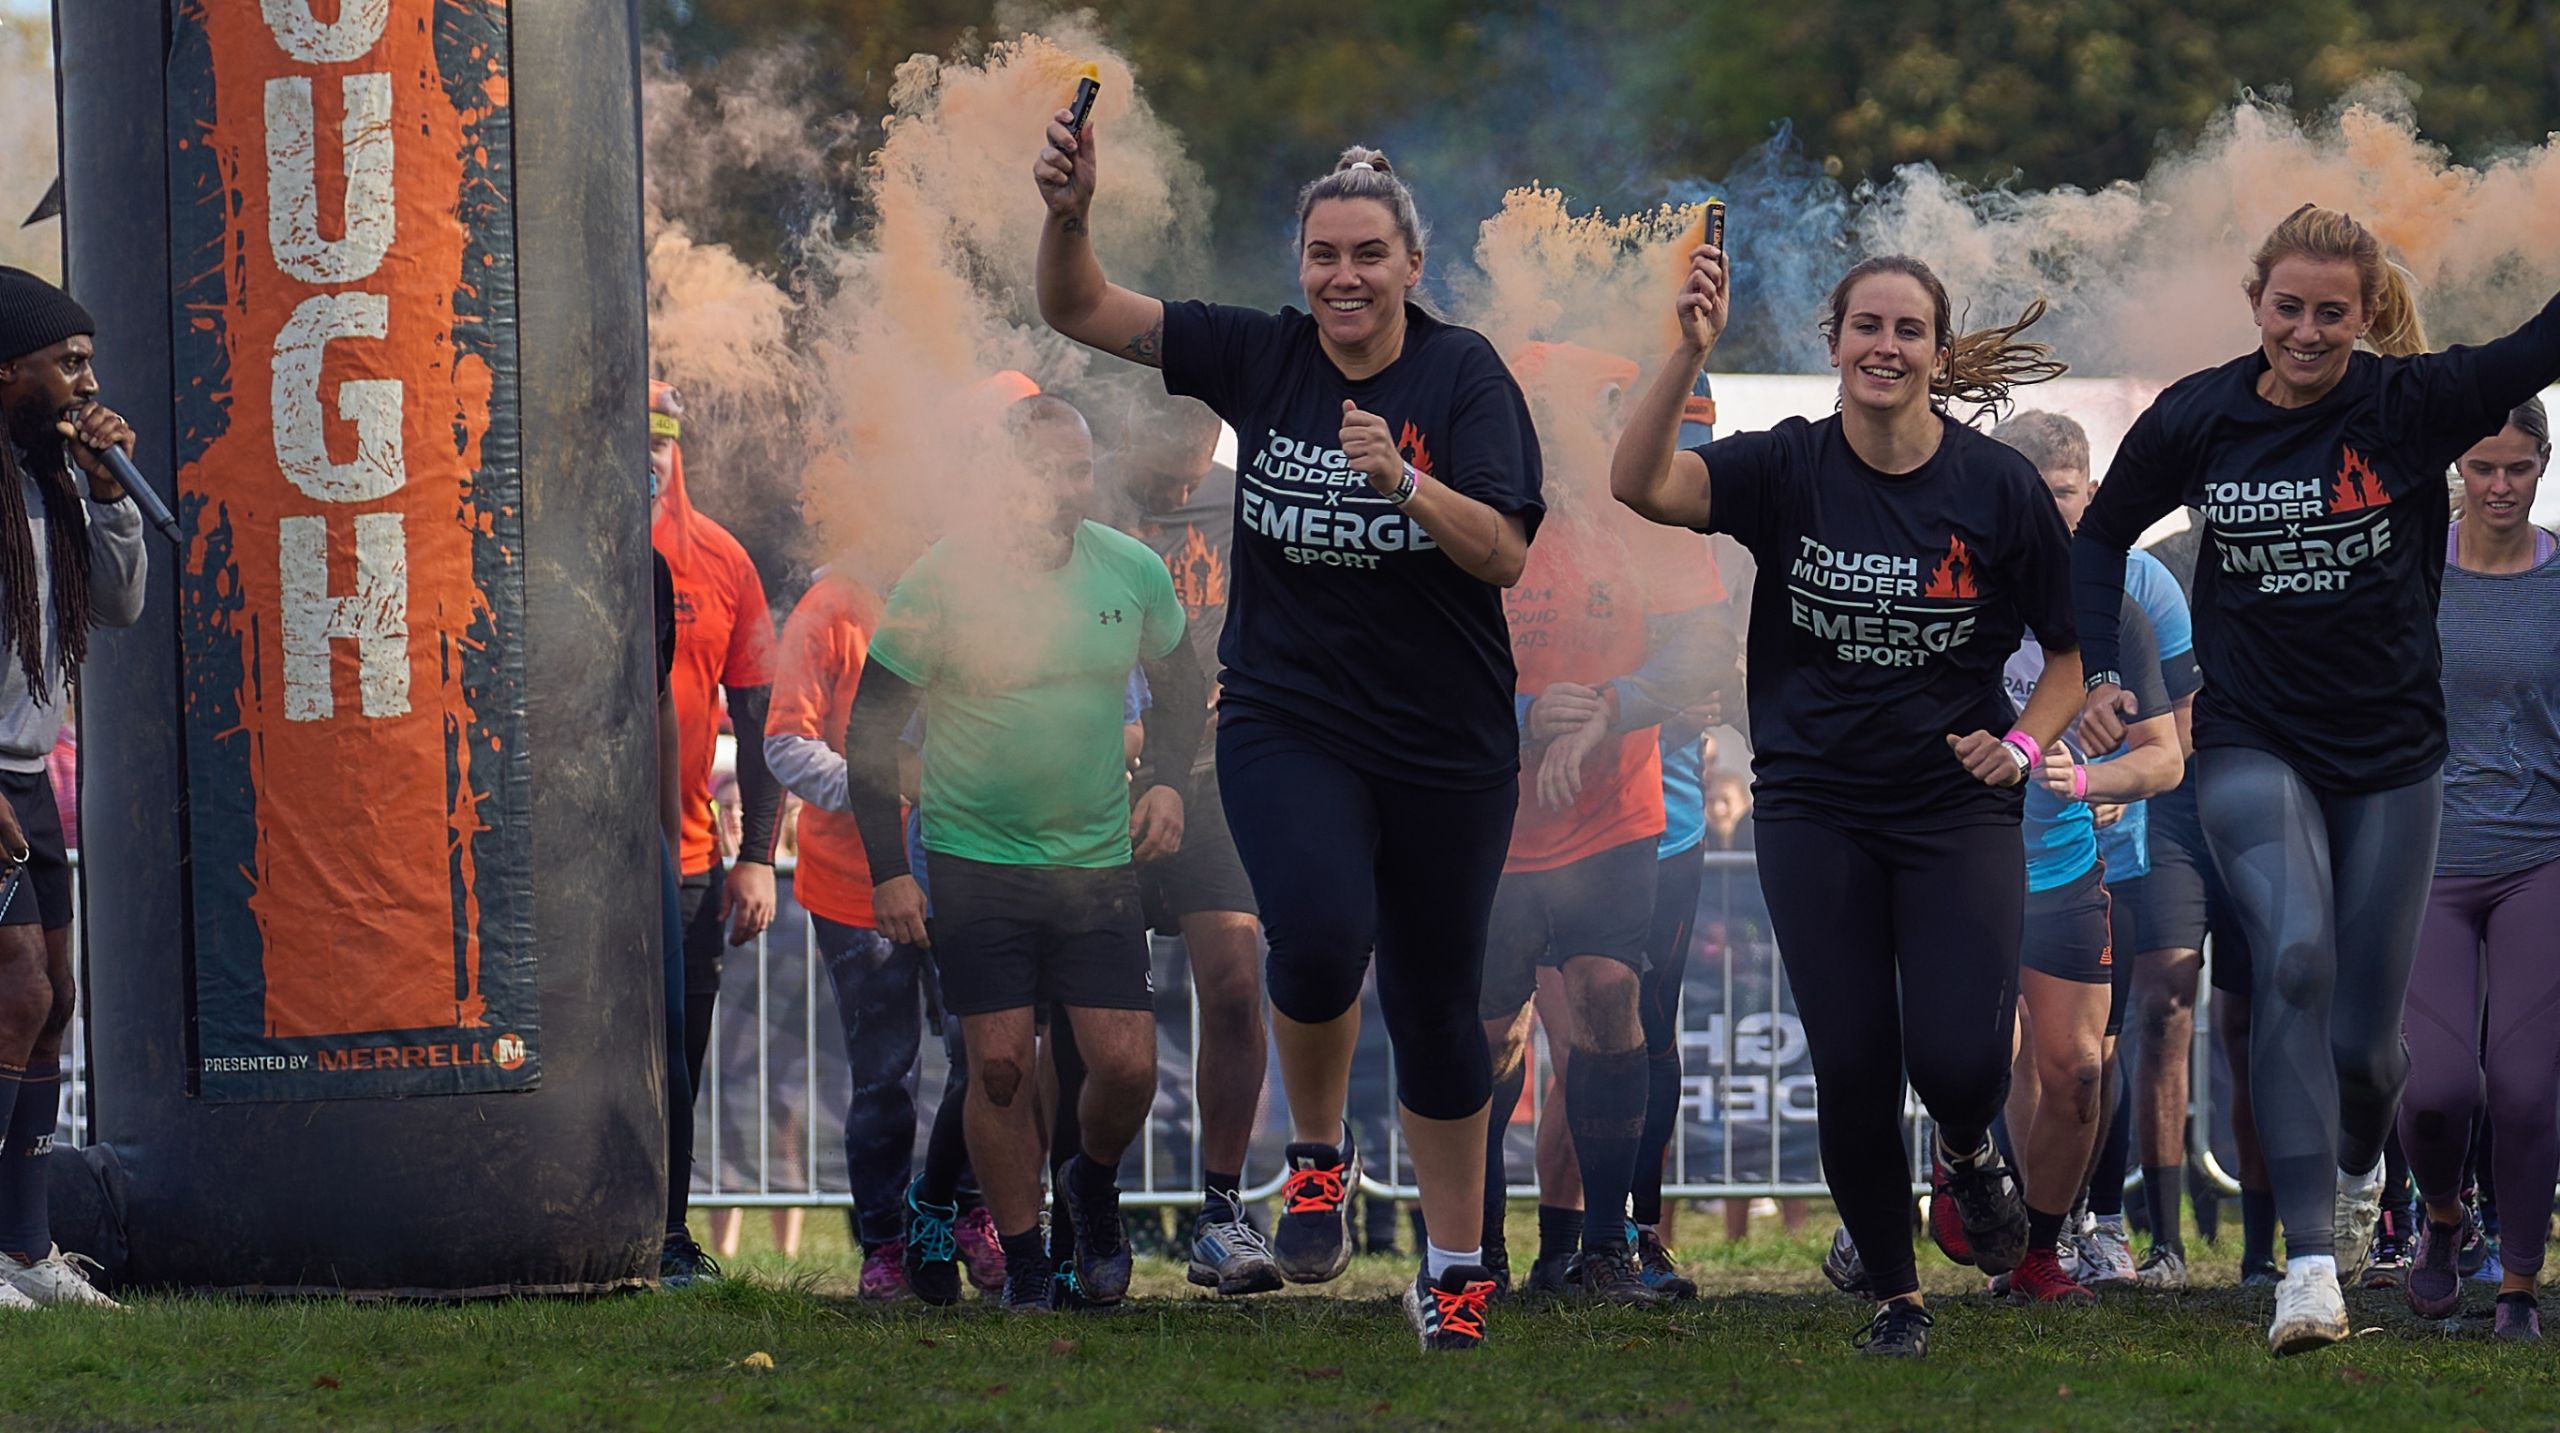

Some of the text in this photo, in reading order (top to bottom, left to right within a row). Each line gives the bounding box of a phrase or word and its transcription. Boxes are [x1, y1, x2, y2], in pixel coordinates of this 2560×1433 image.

[1267, 428, 1352, 470] OUG
[2205, 478, 2322, 503] TOUGH
[2200, 499, 2324, 524] MUDDER
[1283, 546, 1381, 570] SPORT
[1800, 535, 1918, 577] TOUGH
[1791, 558, 1918, 597] MUDDER
[2258, 570, 2351, 594] SPORT
[1791, 596, 1977, 653] EMERGE
[1837, 644, 1930, 667] SPORT
[204, 1056, 286, 1072] PRESENTED
[290, 1055, 308, 1069] BY
[317, 1044, 490, 1072] MERRELL
